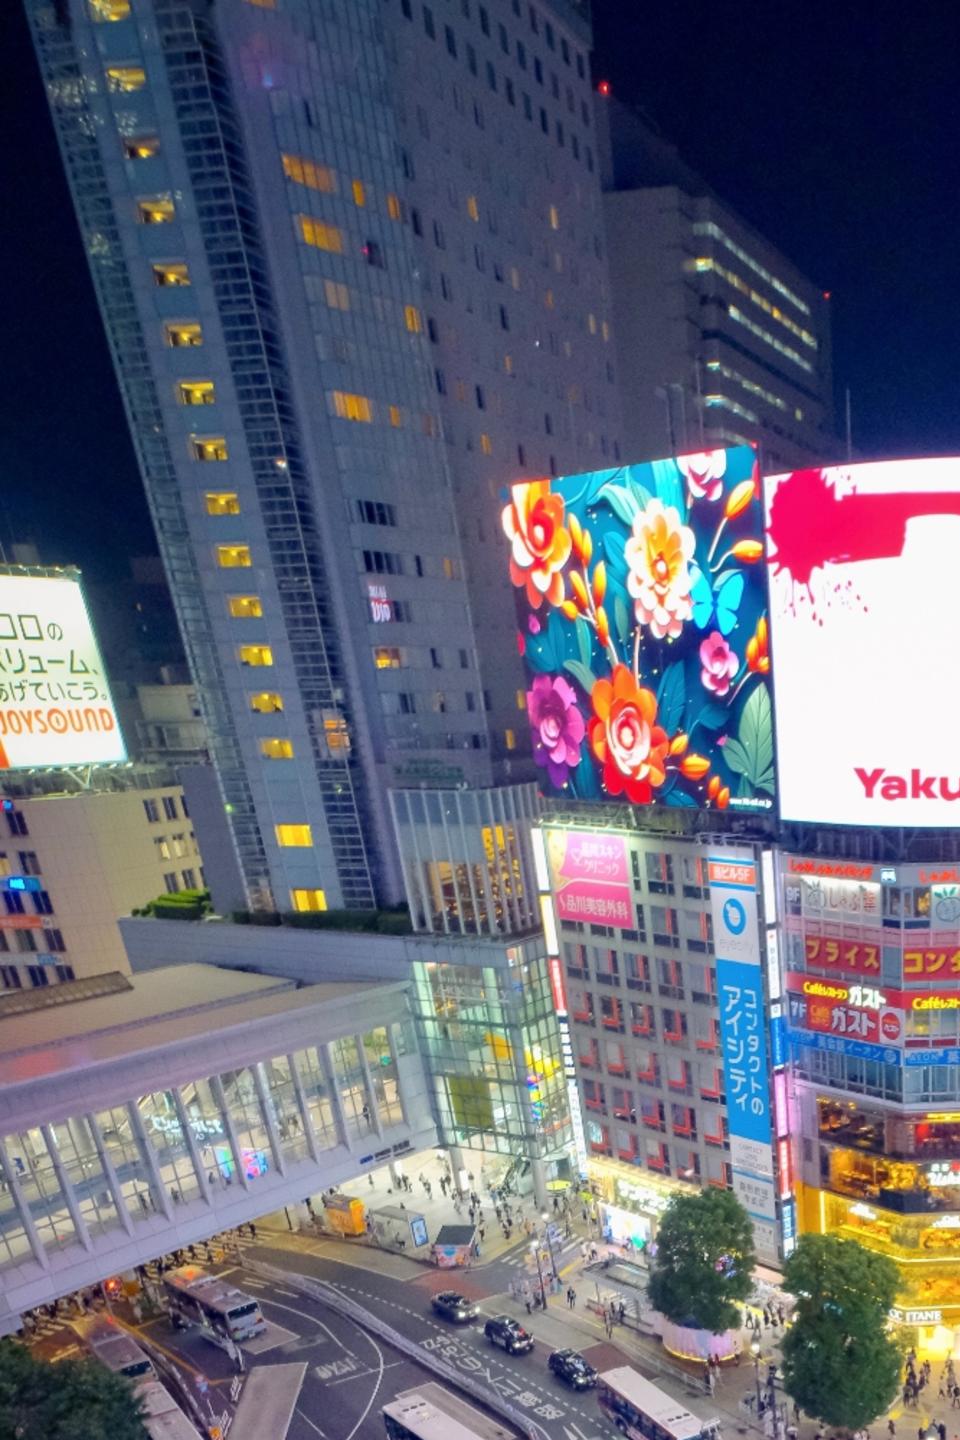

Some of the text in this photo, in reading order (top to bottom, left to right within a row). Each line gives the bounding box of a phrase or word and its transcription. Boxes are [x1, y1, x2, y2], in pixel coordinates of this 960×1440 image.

[0, 648, 99, 675] リューム、
[848, 984, 887, 1010] ガスト
[831, 1006, 876, 1037] ガスト
[722, 984, 748, 1112] アイシティ
[743, 988, 765, 1117] コンタクトの
